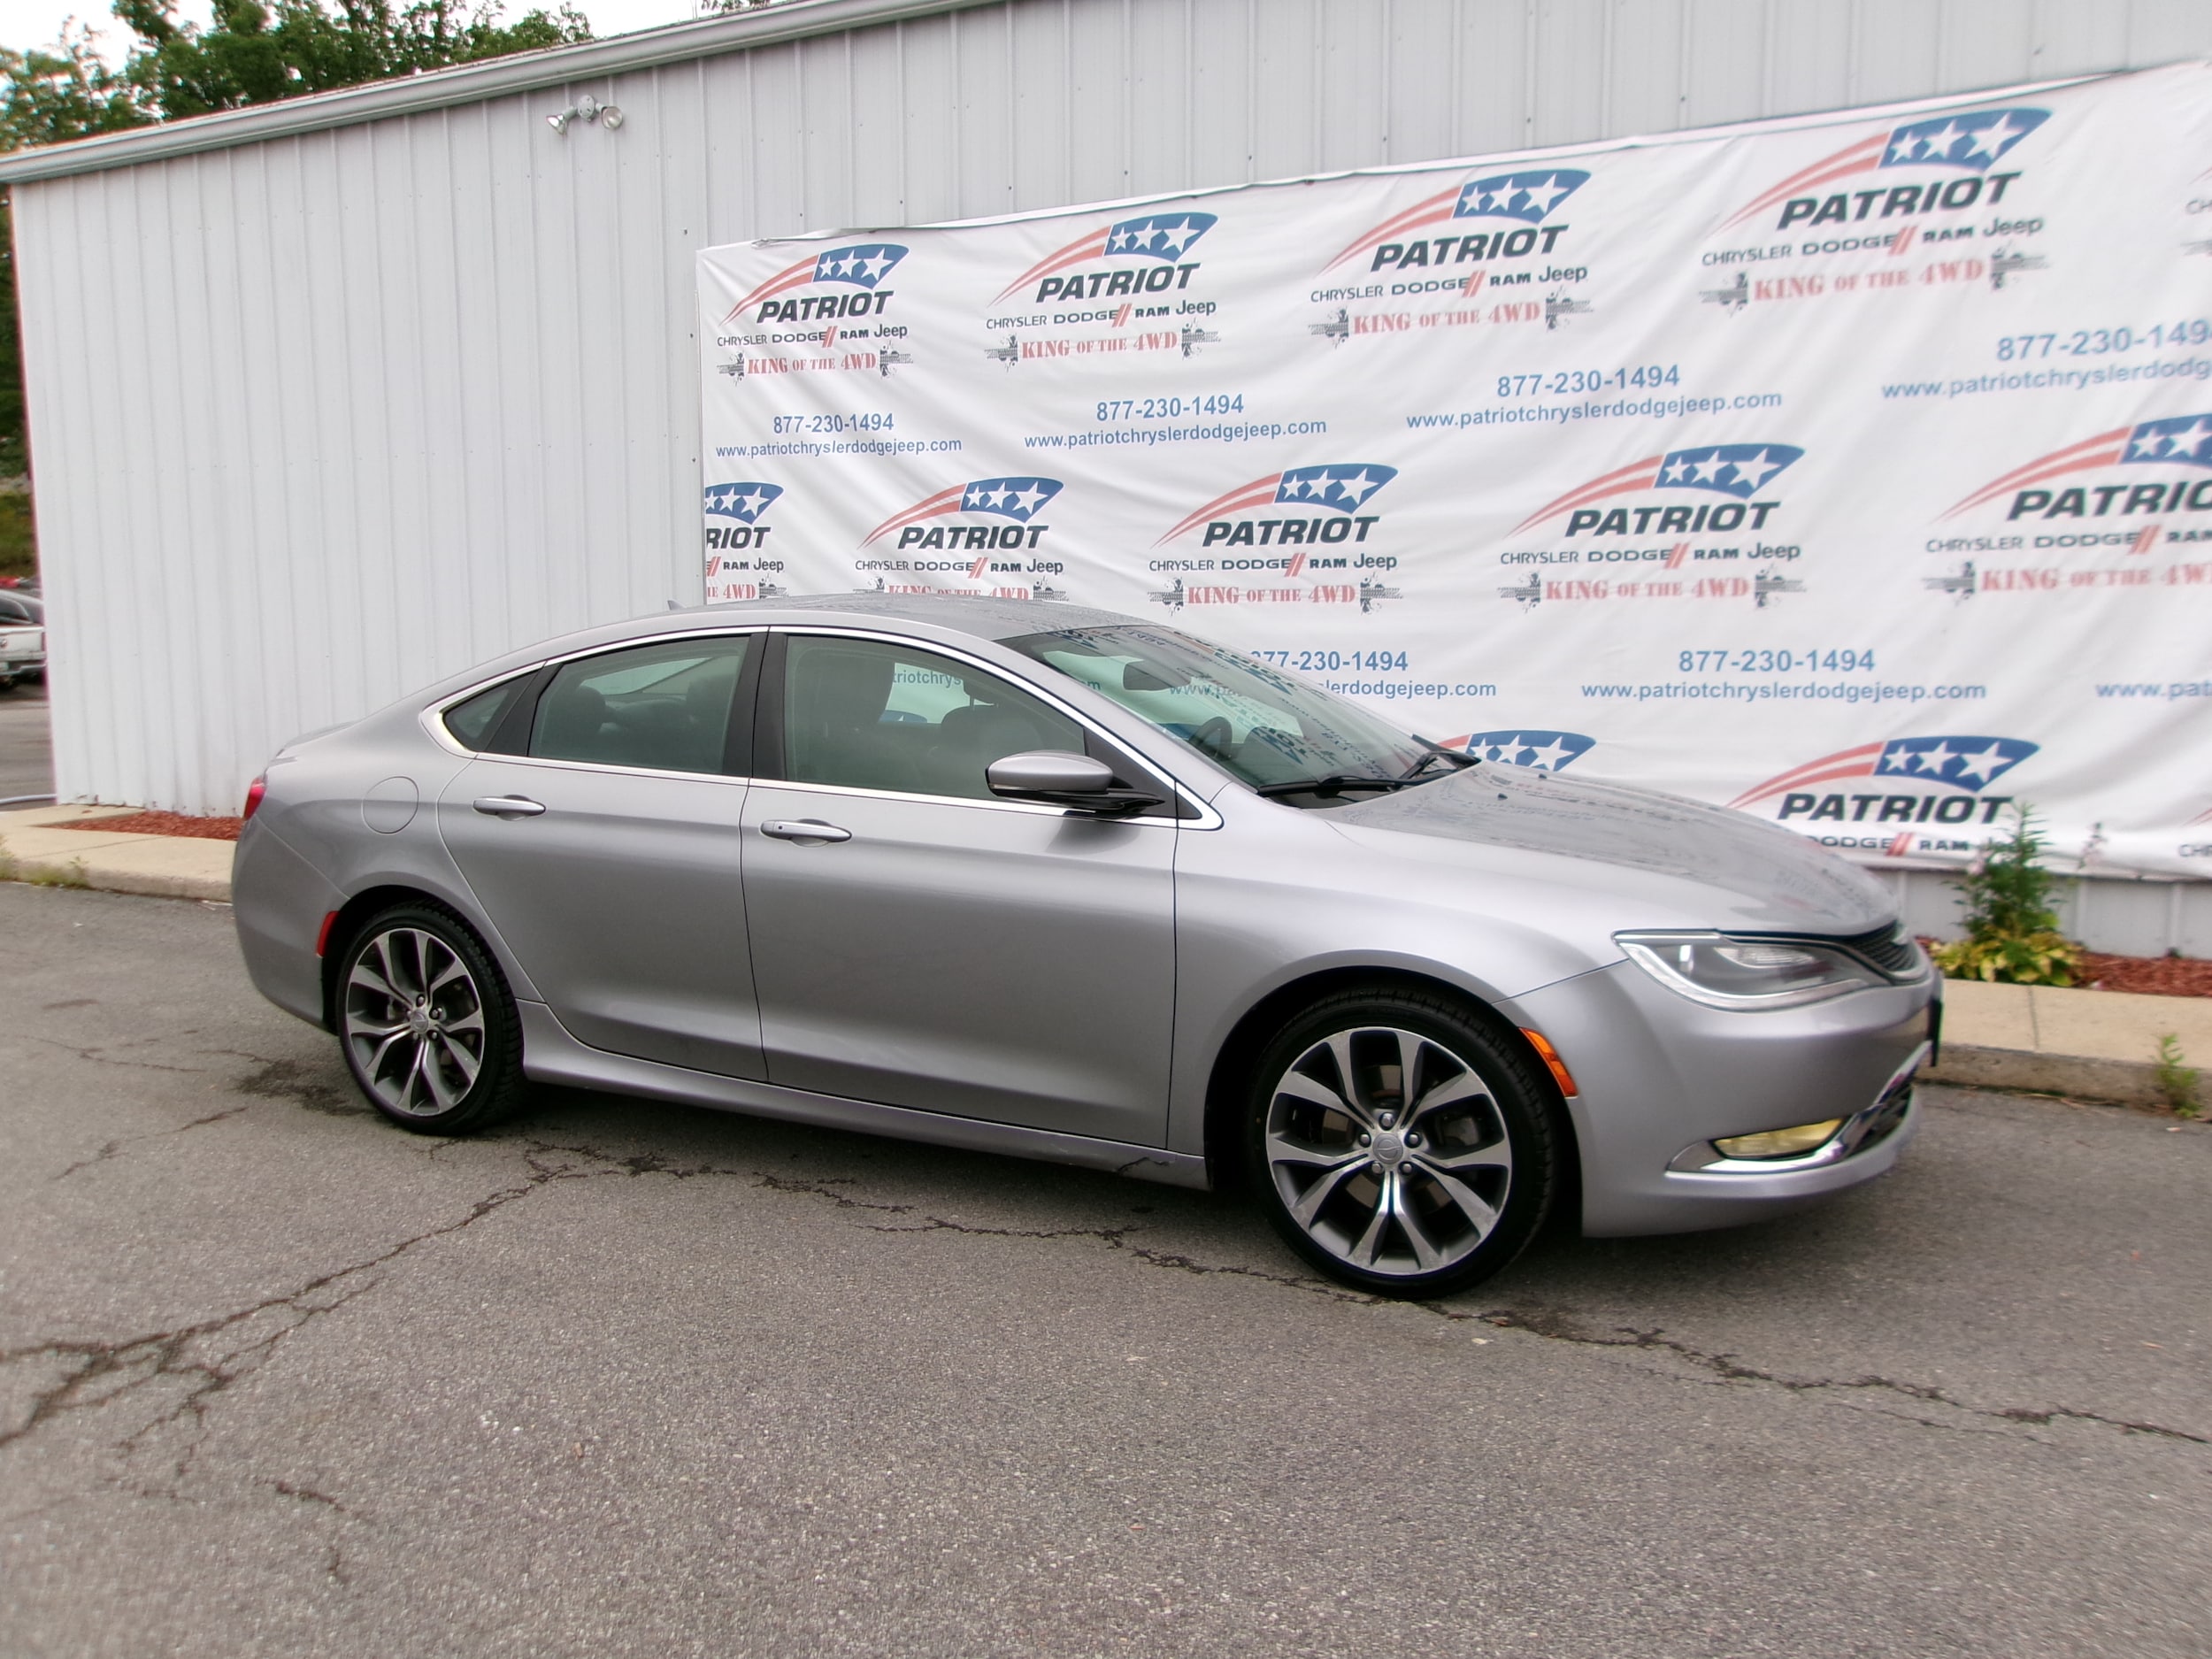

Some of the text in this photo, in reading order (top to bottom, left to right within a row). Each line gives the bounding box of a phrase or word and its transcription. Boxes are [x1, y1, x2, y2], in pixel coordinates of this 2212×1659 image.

[1777, 170, 2024, 231] PATRIOT
[1371, 224, 1569, 273] PATRIOT
[1701, 217, 2044, 266] CHRYSLER DODGE RAM Jeep
[1036, 263, 1201, 303] PATRIOT
[1310, 265, 1587, 303] CHRYSLER DODGE RAM Jeep
[1754, 258, 1984, 301] KING OF THE 4WD
[757, 290, 895, 323] PATRIOT
[987, 300, 1217, 329] CHRYSLER DODGE RAM Jeep
[1353, 301, 1540, 334] KING OF THE 4WD
[717, 324, 908, 346] CHRYSLER DODGE RAM Jeep
[1022, 331, 1178, 359] KING OF THE 4WD
[1996, 319, 2212, 361] 877-230-149
[747, 352, 876, 374] KING OF THE 4WD
[1496, 364, 1680, 398] 877-230-1494
[1095, 394, 1244, 421] 877-230-1494
[1406, 392, 1783, 429] www.patriotchryslerdodgejeep.com
[773, 413, 895, 434] 877-230-1494
[1024, 420, 1327, 449] www.patriotchryslerdodgejeep.com
[716, 438, 963, 459] www.patriotchryslerdodgejeep.com
[2006, 479, 2212, 521] PATRIO
[1202, 515, 1380, 548] PATRIOT
[1564, 501, 1781, 538] PATRIOT
[706, 526, 772, 549] RIOT
[897, 525, 1049, 549] PATRIOT
[1925, 536, 2024, 553] CHRYSLER
[2034, 532, 2140, 549] DODGE
[723, 561, 749, 570] RAM
[753, 557, 785, 573] Jeep
[855, 558, 1064, 575] CHRYSLER DODGE RAM Jeep
[1149, 553, 1398, 572] CHRYSLER DODGE RAM Jeep
[1500, 541, 1801, 565] CHRYSLER DODGE RAM Jeep
[723, 583, 757, 599] 4WD
[1547, 576, 1750, 601] KING OF THE 4WD
[1981, 564, 2212, 592] KING OF THE 4W
[1187, 584, 1356, 604] KING OF THE 4WD
[1678, 648, 1876, 672] 877-230-1494
[1319, 680, 1496, 699] lerdodgejeep.com
[1581, 680, 1986, 703] www.patriotchryslerdodgejeep.com
[1777, 793, 2014, 824] PATRIOT
[1919, 839, 1970, 851] RAM
